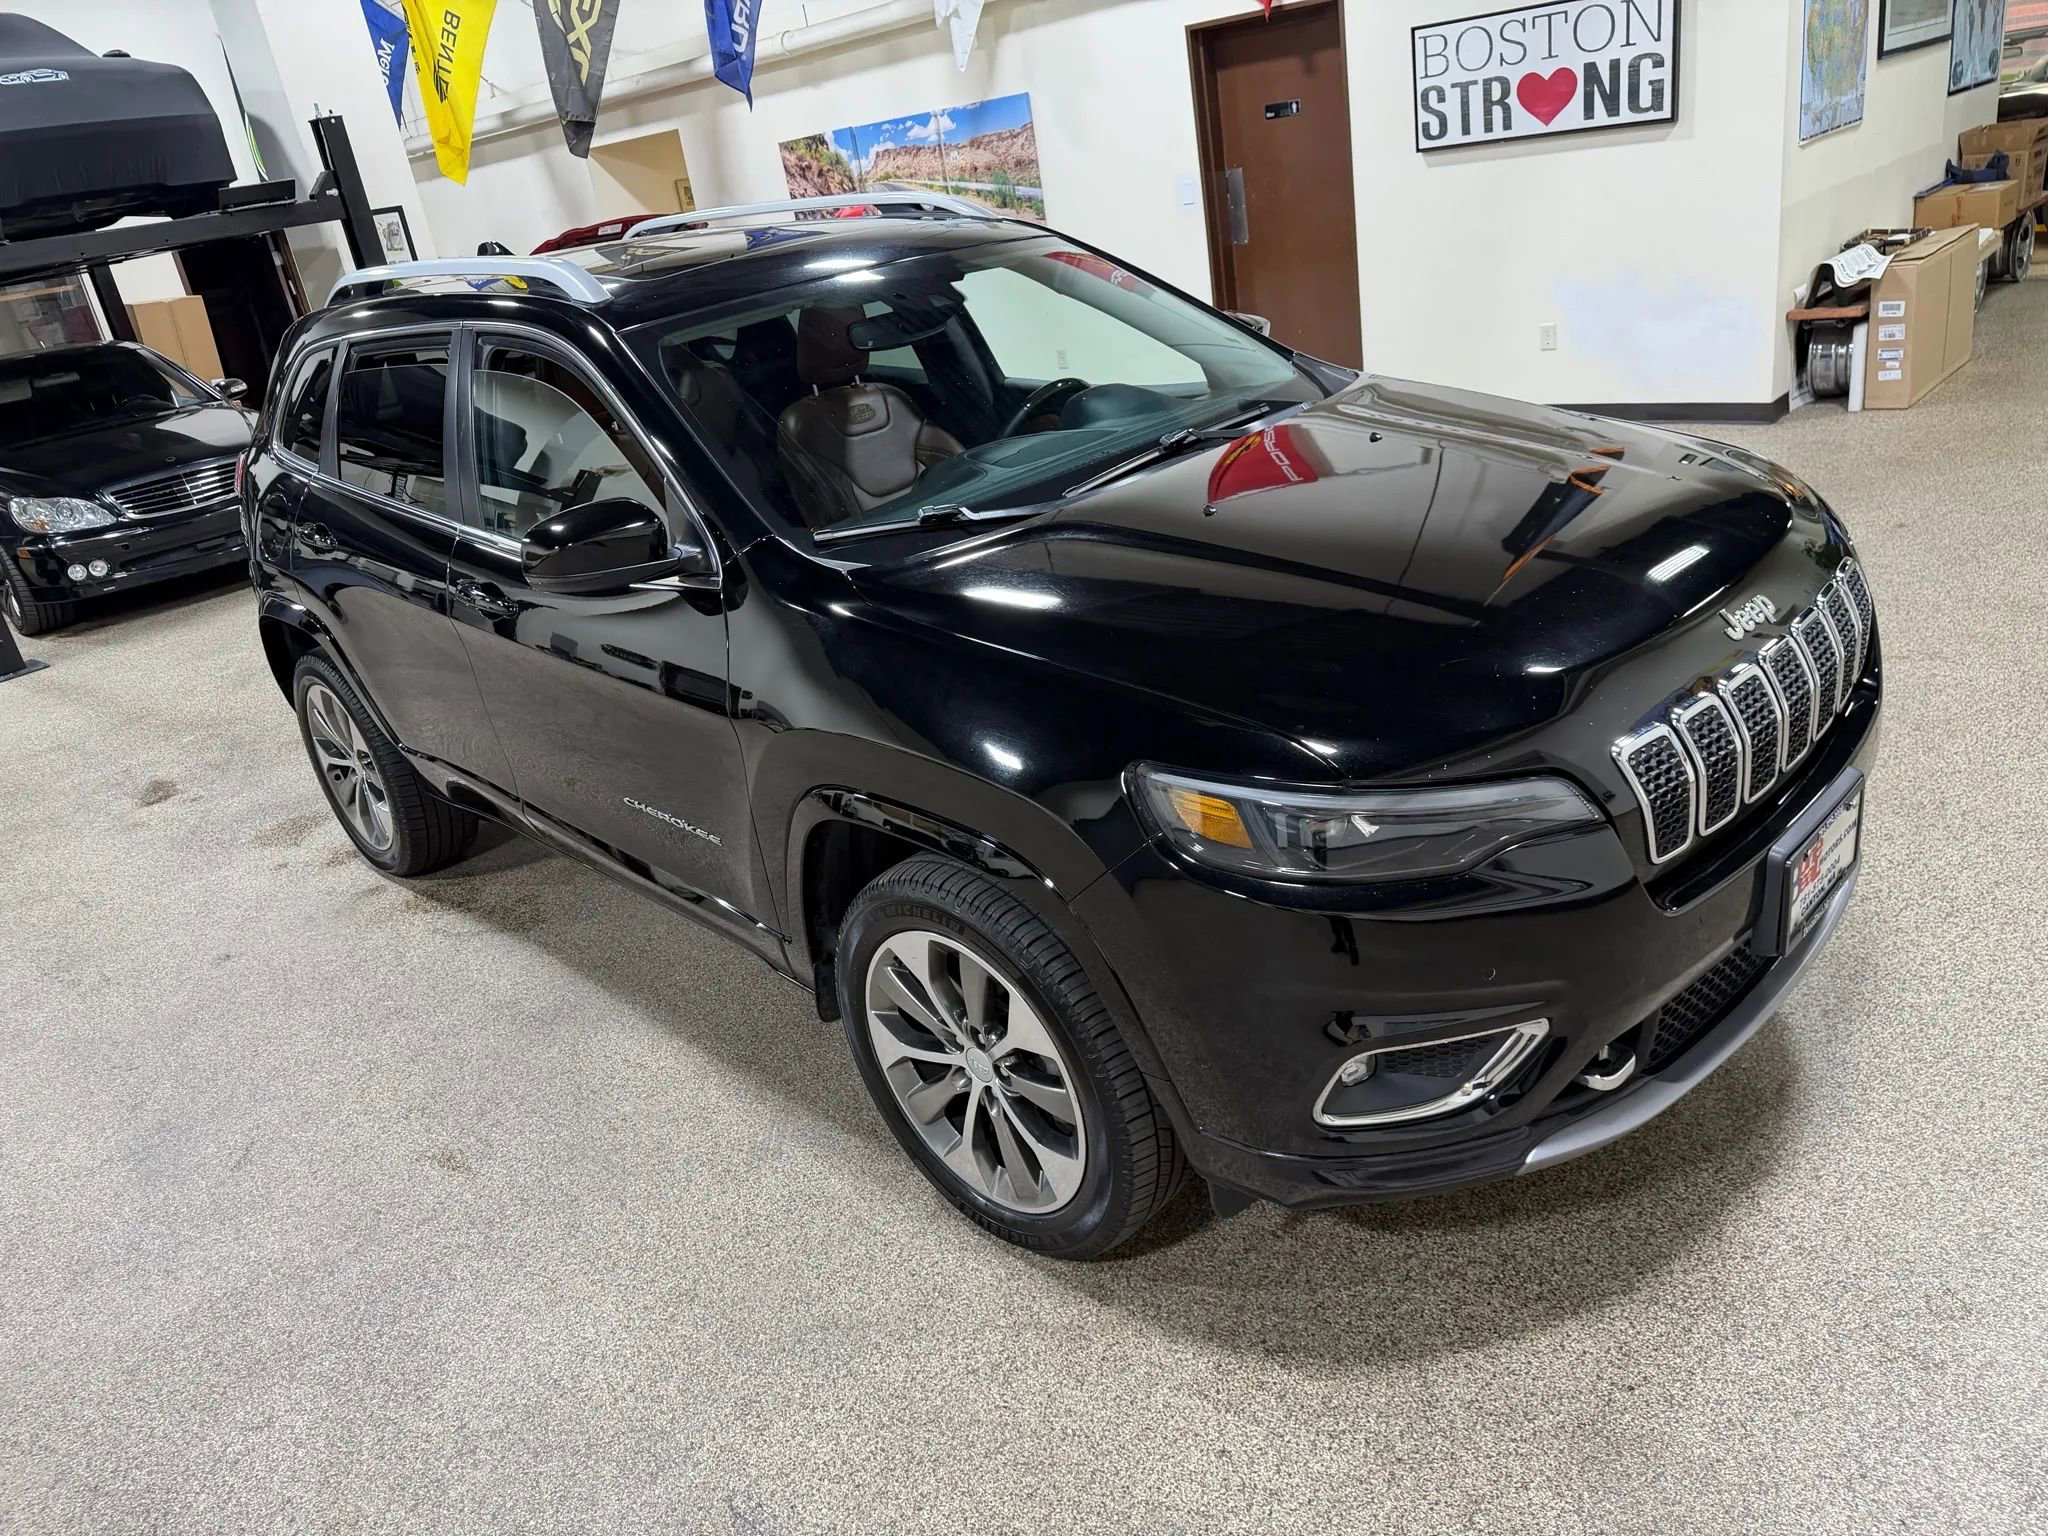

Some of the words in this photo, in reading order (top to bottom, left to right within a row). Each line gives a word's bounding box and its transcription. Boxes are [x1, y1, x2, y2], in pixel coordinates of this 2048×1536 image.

[1418, 0, 1662, 80] BOSTON
[1419, 52, 1665, 141] STRNG
[1717, 594, 1776, 641] Jeep
[623, 797, 723, 847] CHEROKEE
[885, 903, 965, 936] MICHELIN
